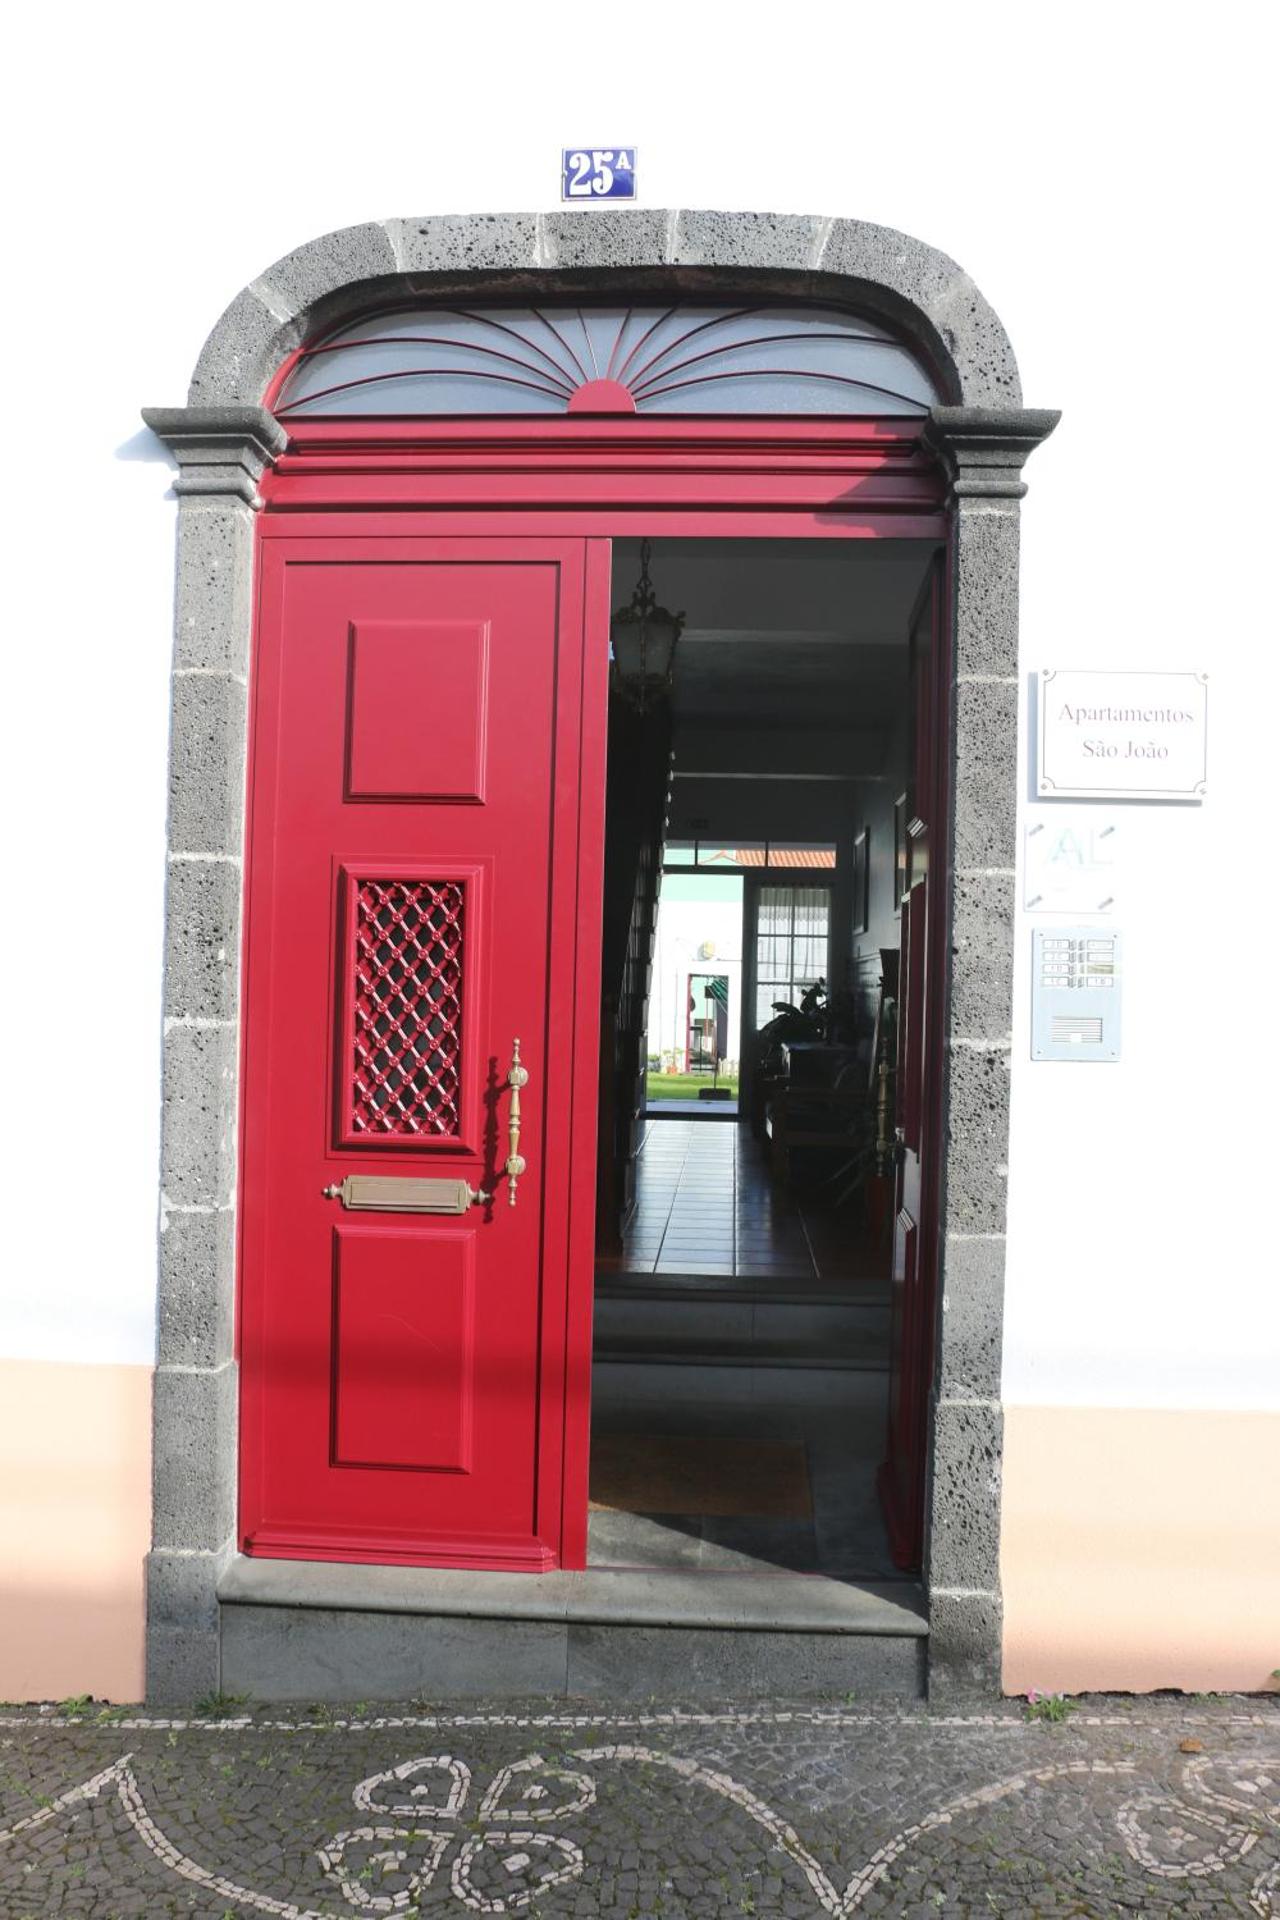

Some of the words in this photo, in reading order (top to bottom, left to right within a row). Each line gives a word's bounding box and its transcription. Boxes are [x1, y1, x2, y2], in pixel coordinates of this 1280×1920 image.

[1058, 703, 1195, 726] Apartamentos
[1082, 739, 1118, 758] São
[1124, 740, 1169, 759] João
